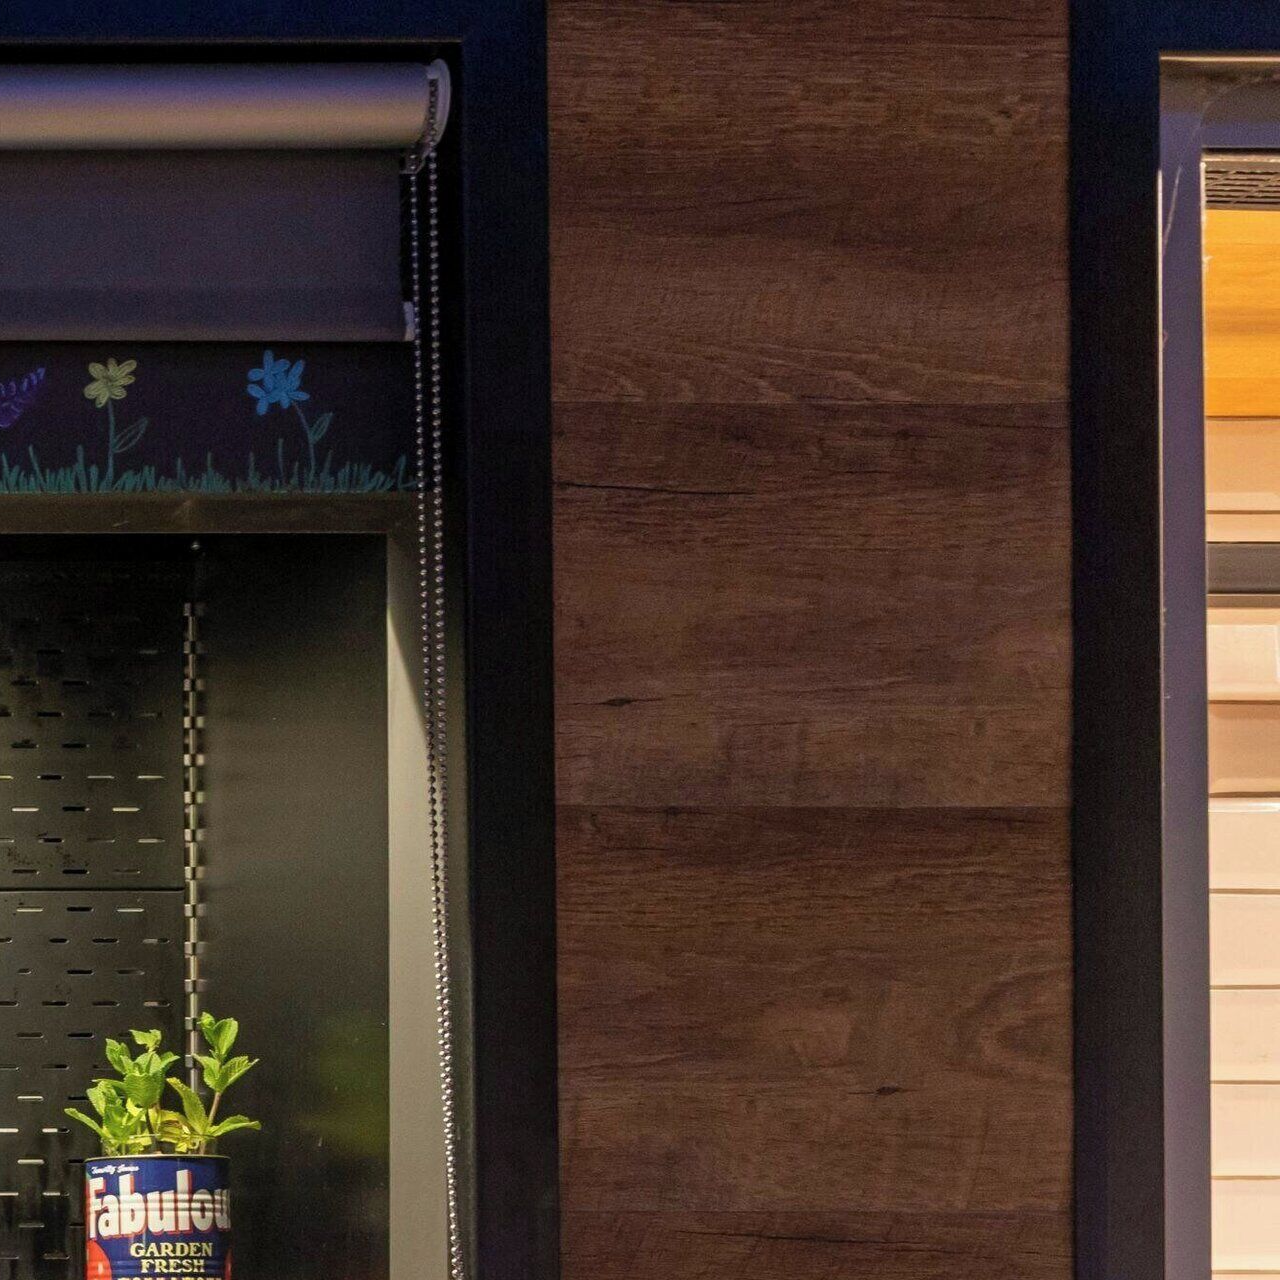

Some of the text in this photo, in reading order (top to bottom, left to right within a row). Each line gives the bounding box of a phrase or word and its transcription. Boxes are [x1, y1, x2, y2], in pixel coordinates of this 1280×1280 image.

[89, 1169, 232, 1239] Fabulou
[129, 1242, 214, 1258] GARDEN
[140, 1258, 206, 1273] FRESH
